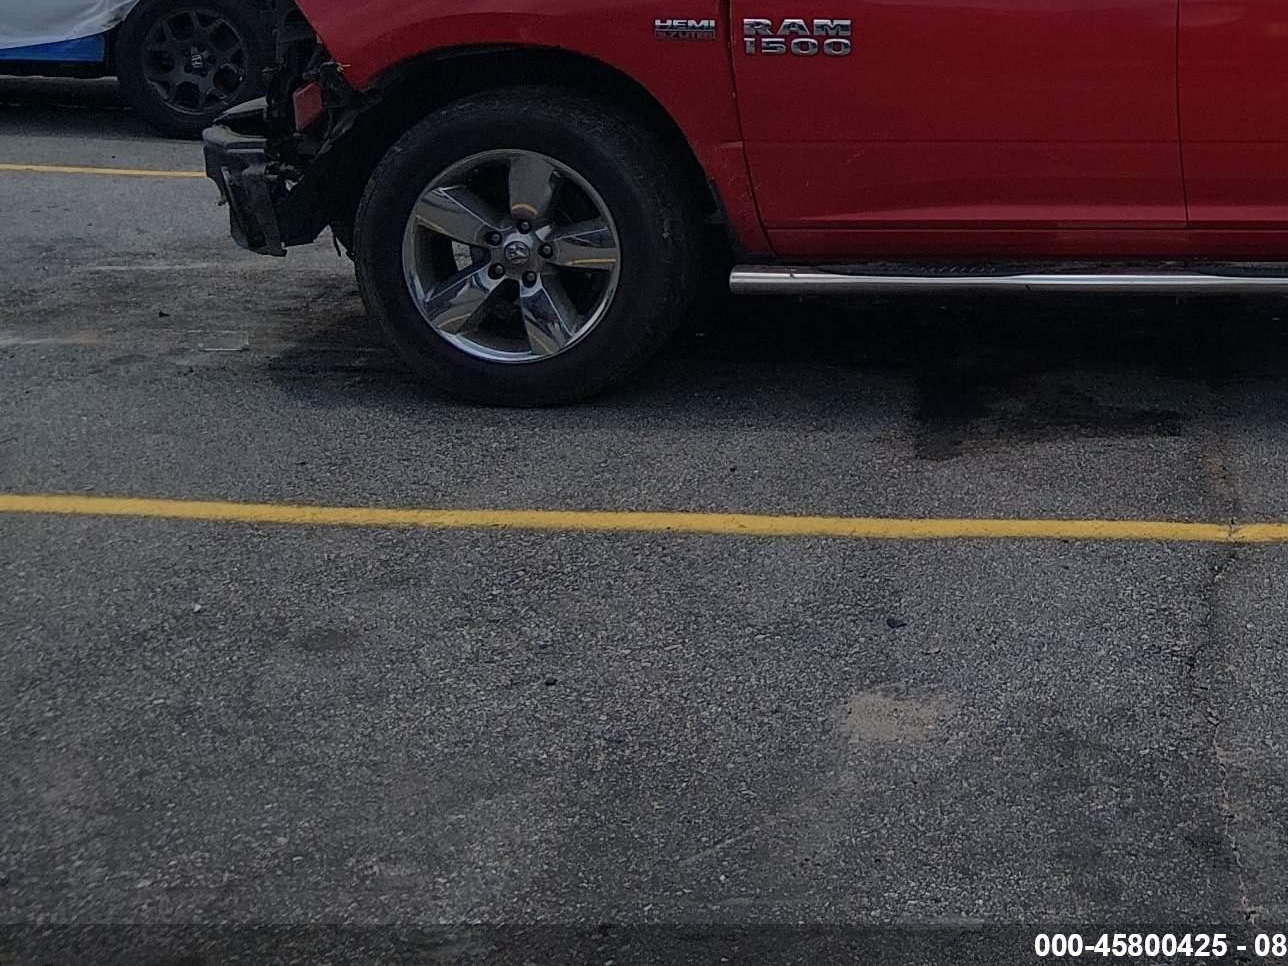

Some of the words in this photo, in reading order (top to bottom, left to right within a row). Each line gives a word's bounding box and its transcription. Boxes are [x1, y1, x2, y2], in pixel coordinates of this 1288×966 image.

[655, 19, 716, 30] HEMI
[743, 19, 852, 36] RAM
[744, 38, 851, 56] 1500
